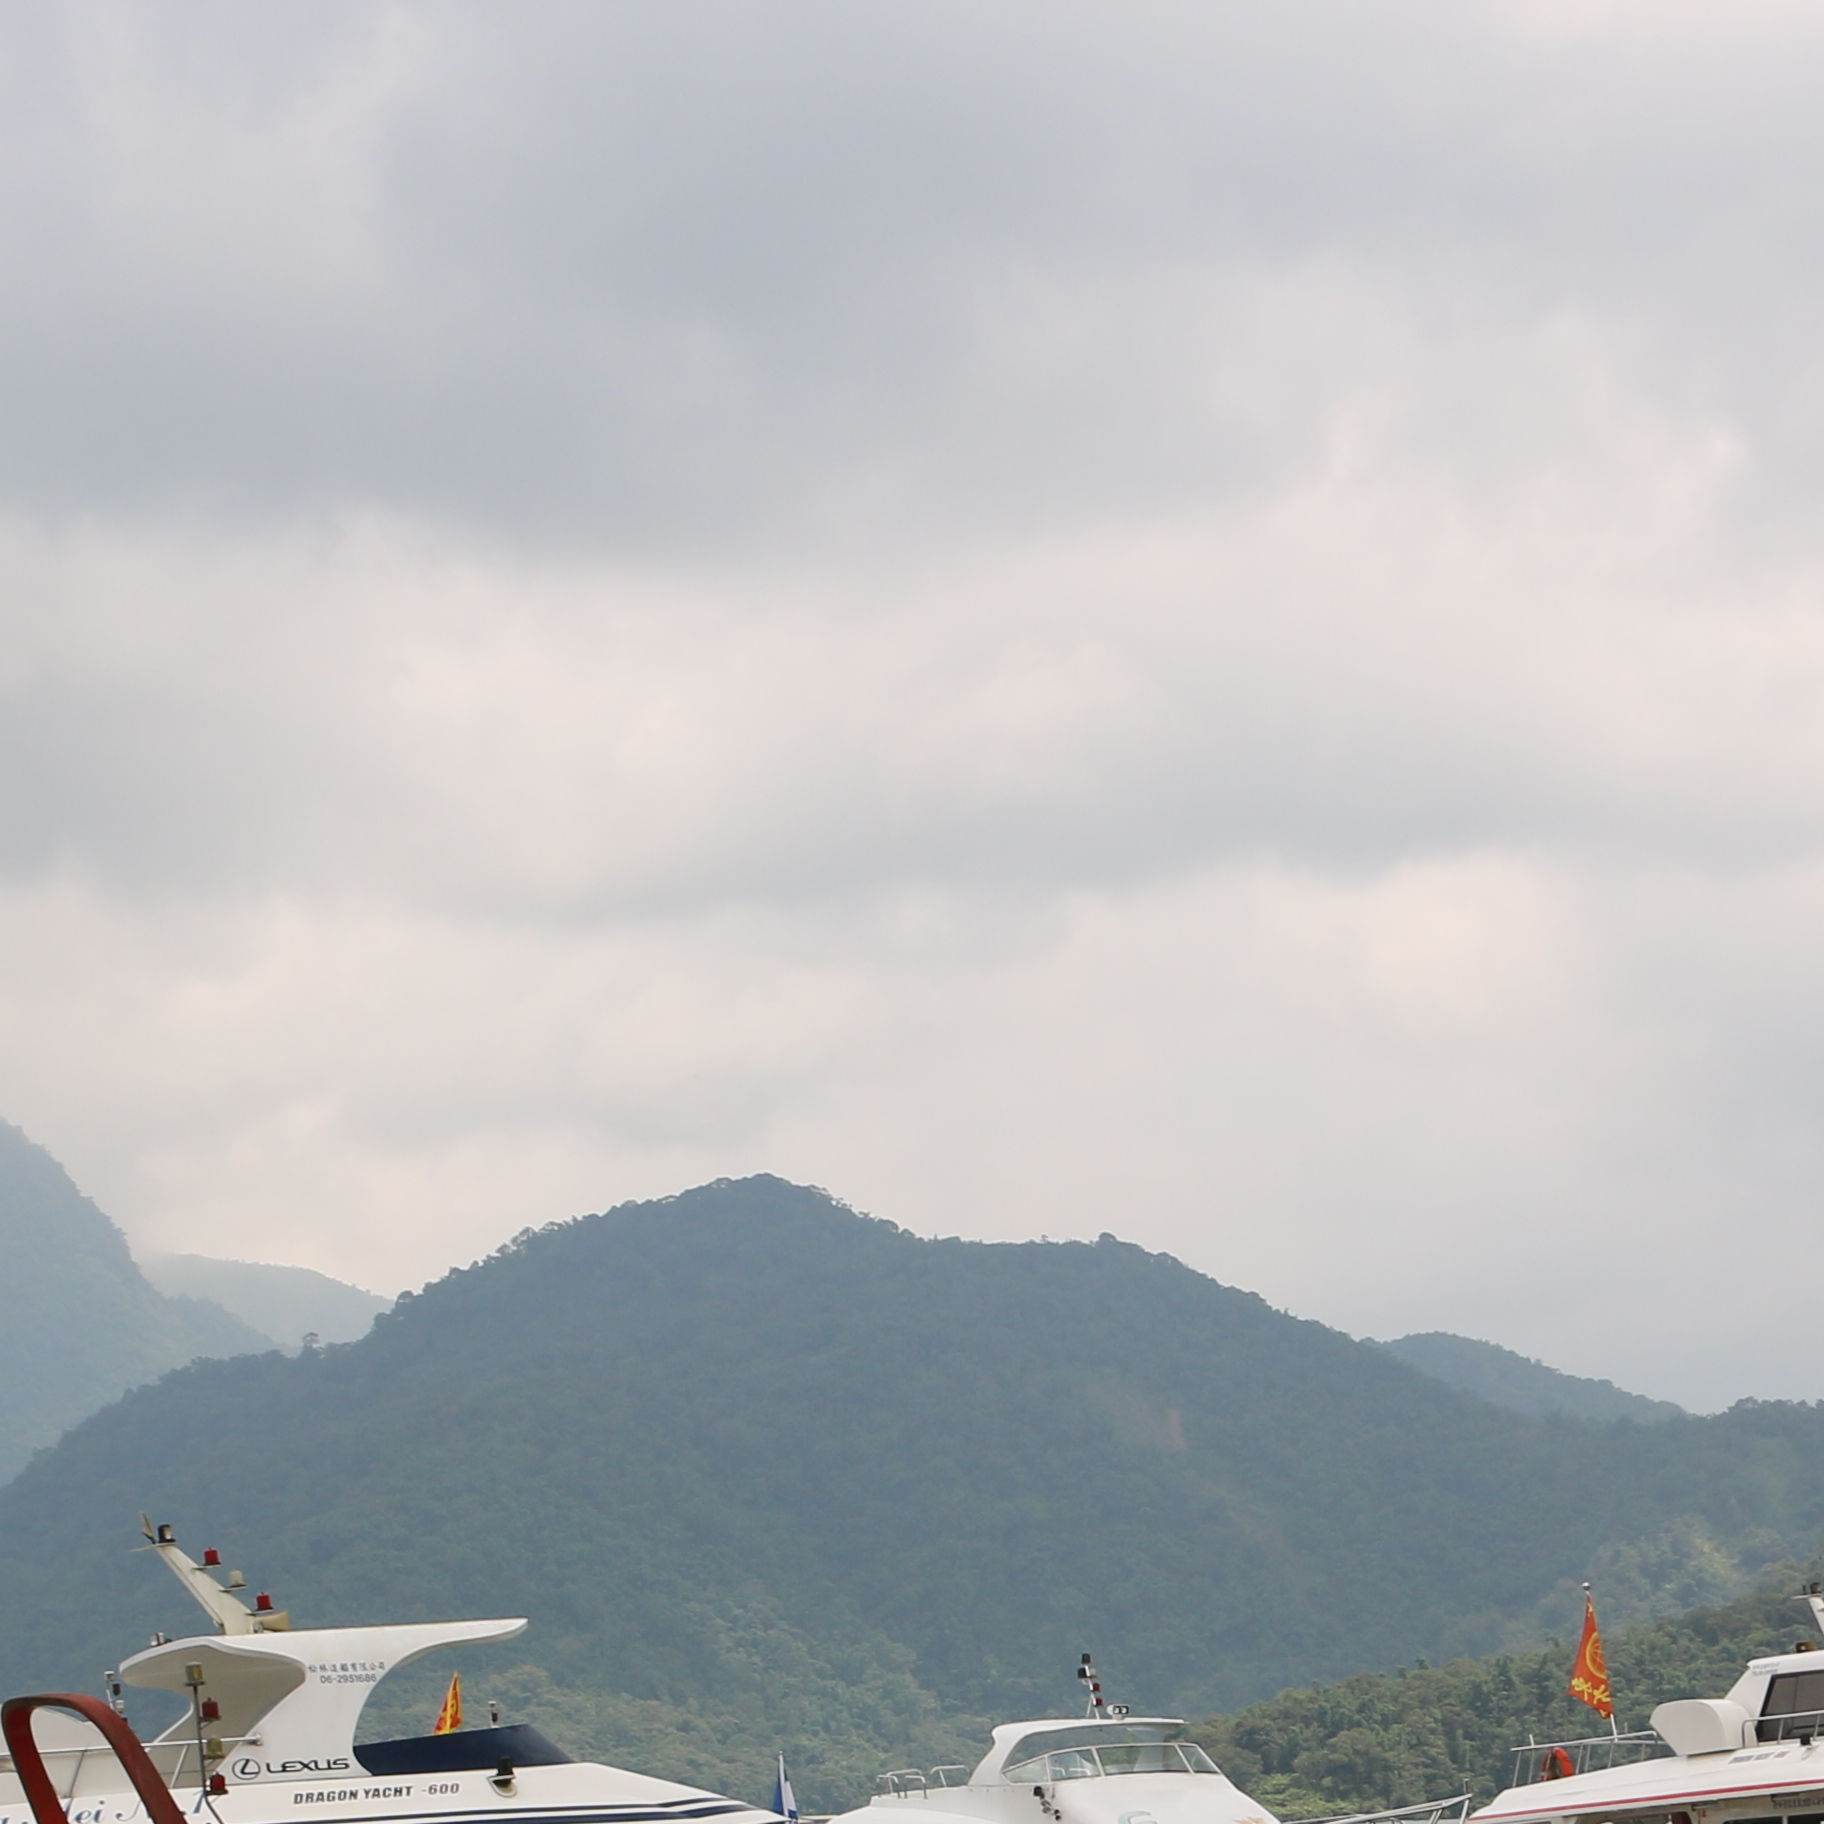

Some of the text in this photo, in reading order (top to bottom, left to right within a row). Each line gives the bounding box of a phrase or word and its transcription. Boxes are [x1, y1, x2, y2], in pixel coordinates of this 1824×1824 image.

[266, 1757, 350, 1773] LEXUS
[293, 1783, 460, 1804] DRAGON YACHT -600
